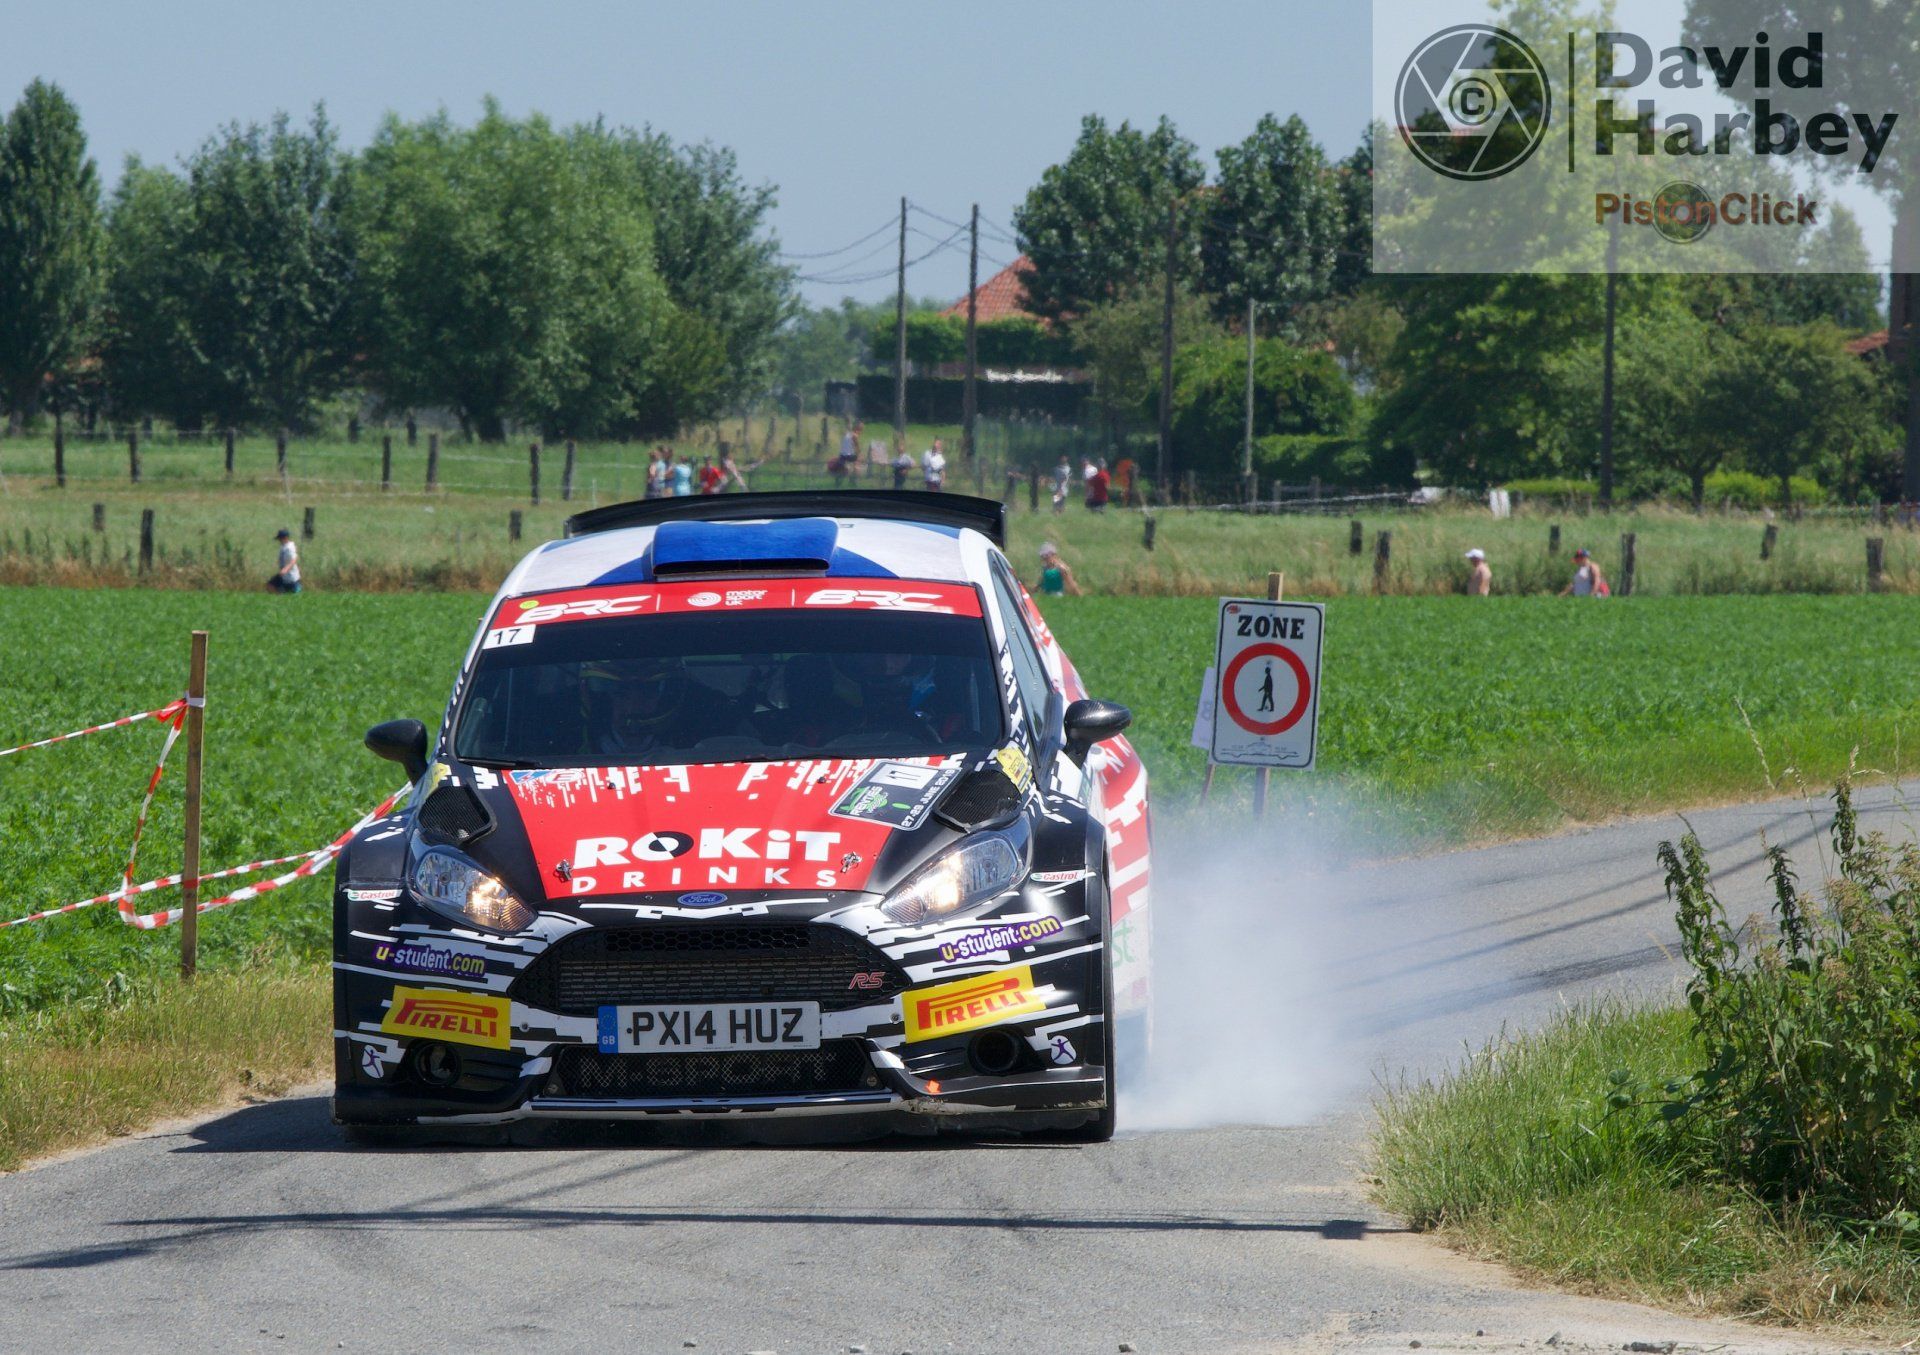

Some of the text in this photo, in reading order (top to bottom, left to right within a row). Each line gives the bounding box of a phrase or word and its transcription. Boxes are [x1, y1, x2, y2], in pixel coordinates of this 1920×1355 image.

[804, 589, 943, 607] BRC
[514, 595, 652, 624] BRC
[493, 628, 521, 644] 17
[1237, 614, 1305, 640] ZONE
[919, 785, 940, 804] JUNE
[571, 866, 838, 894] DRINKS
[1043, 871, 1078, 881] Castrol
[361, 890, 396, 900] Castrol
[688, 894, 717, 903] Ford
[941, 916, 1061, 962] u-student.com
[376, 945, 485, 976] u-student.com
[848, 972, 885, 989] RS
[916, 976, 1023, 1031] PIRELLI
[394, 997, 499, 1038] PIRELLI
[632, 1008, 804, 1046] PX14 HUZ
[602, 1035, 615, 1045] GB
